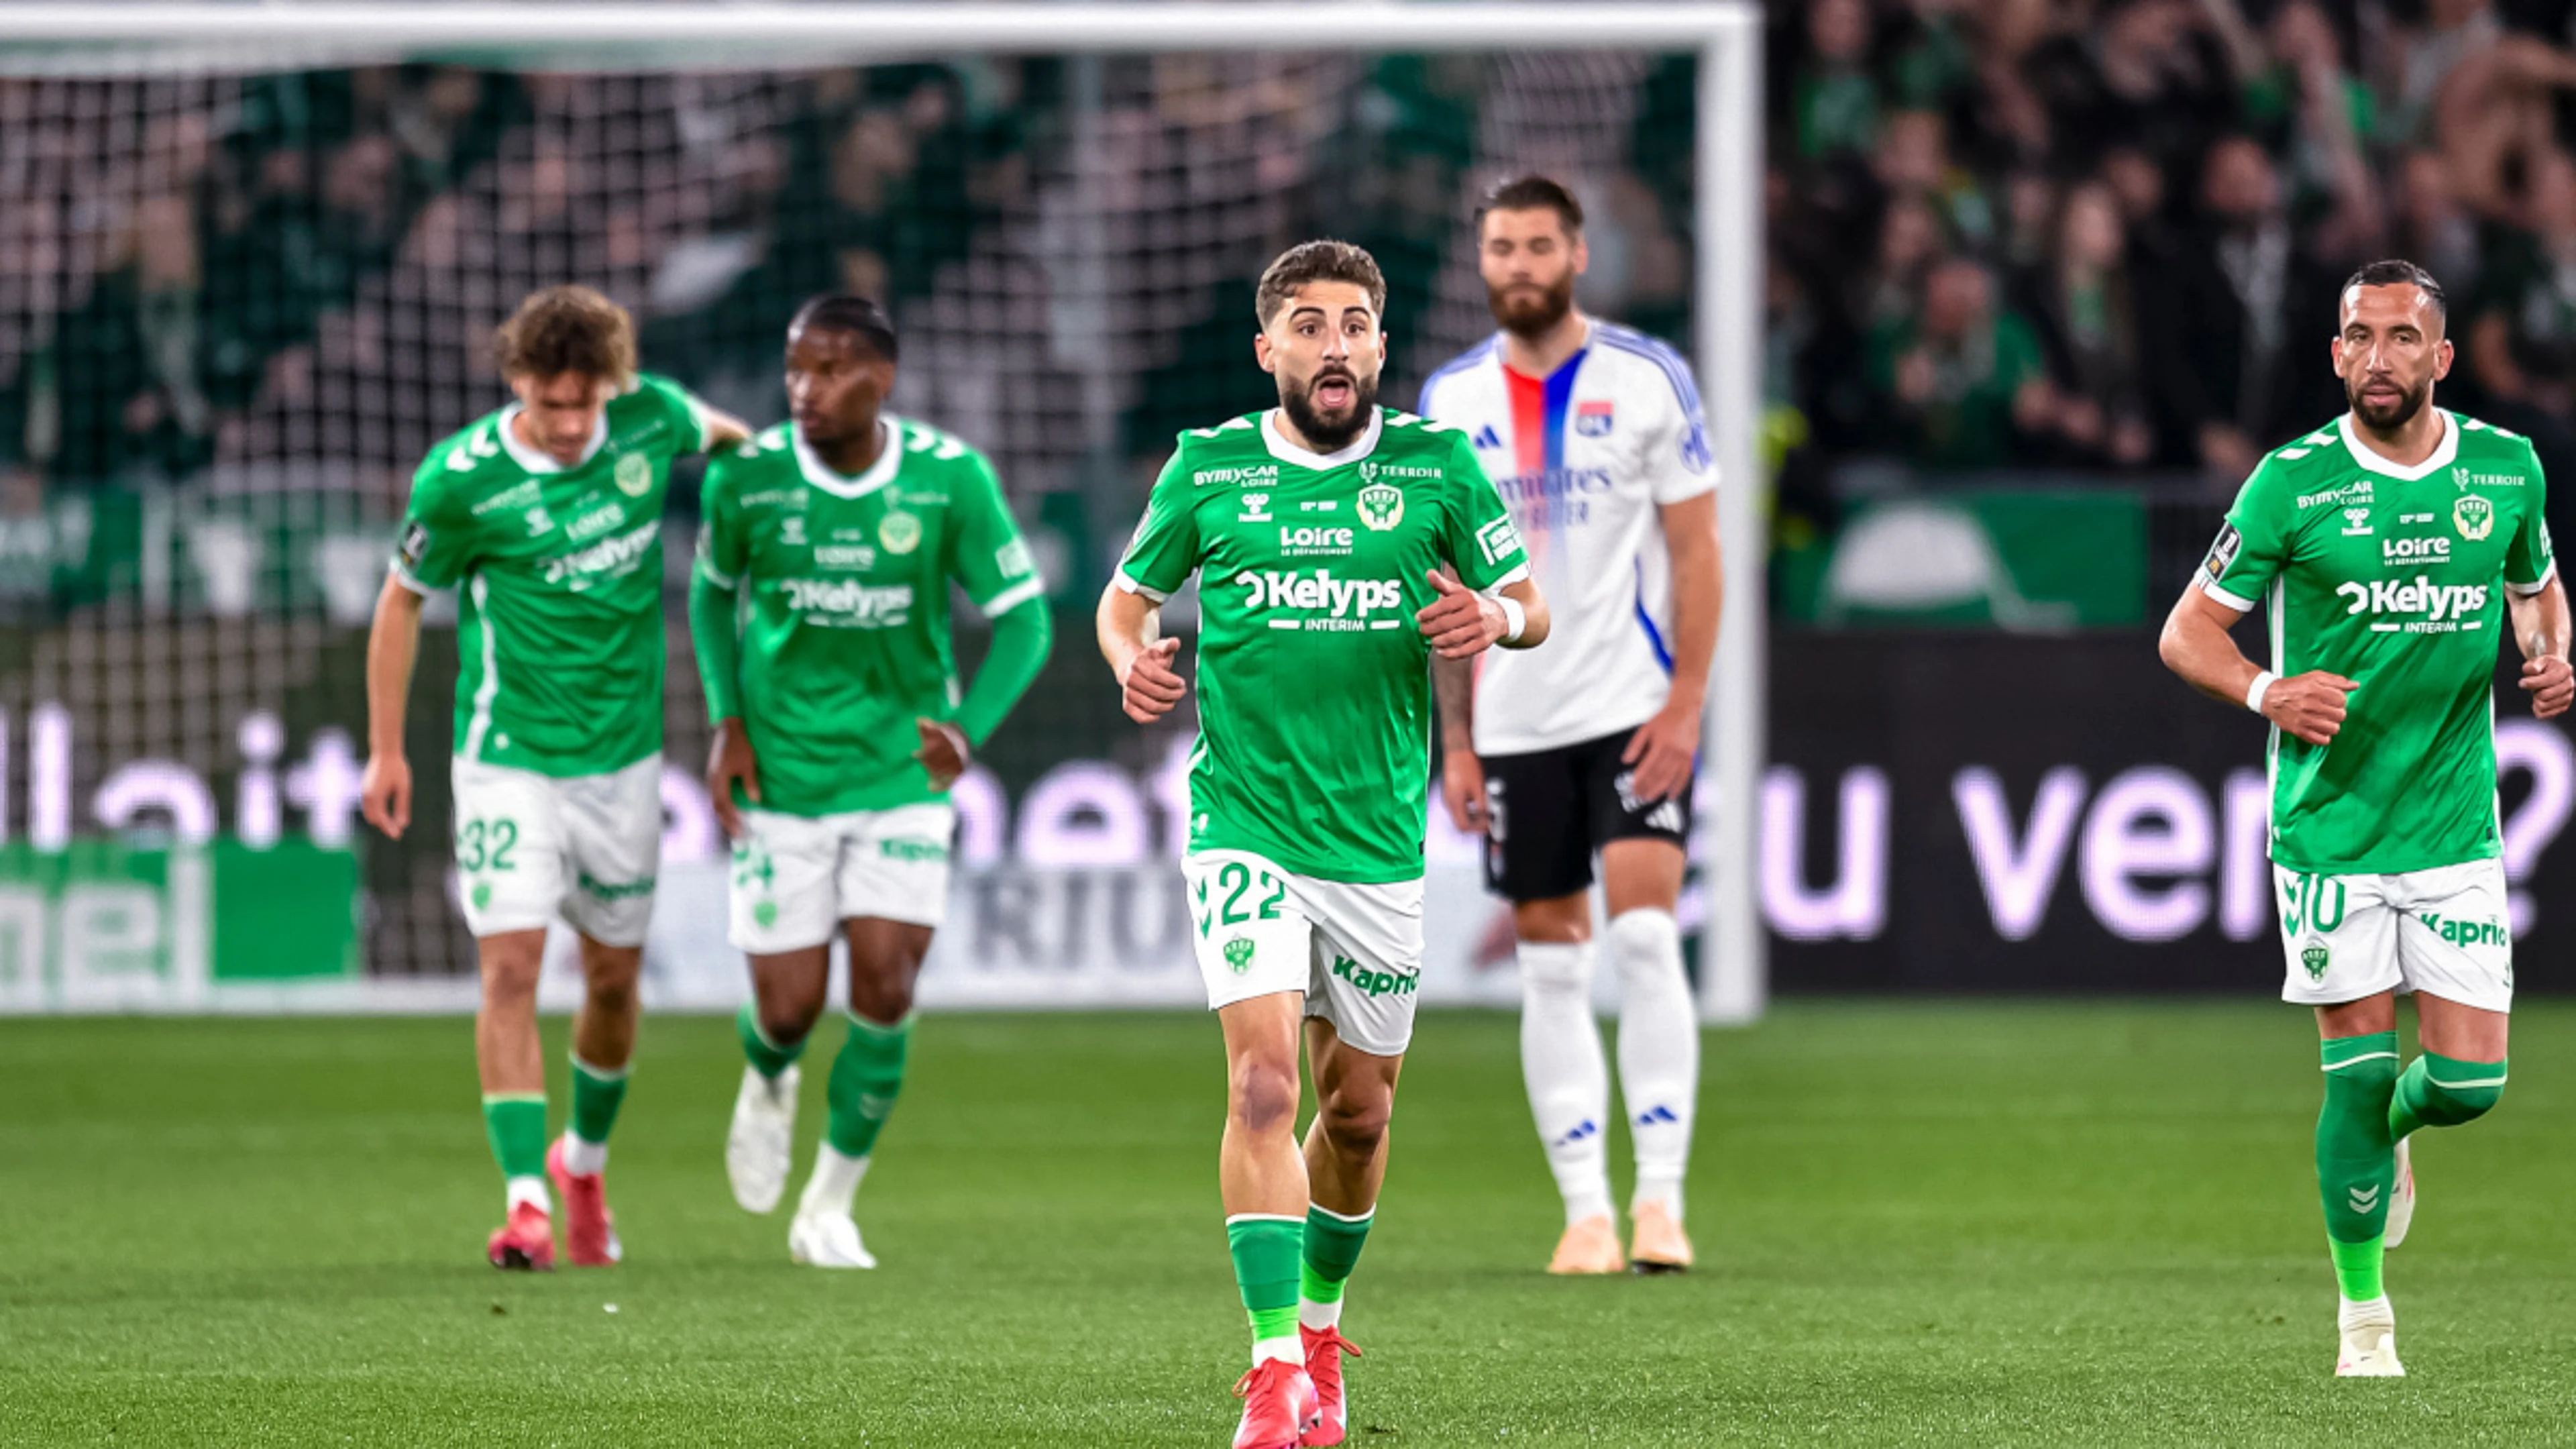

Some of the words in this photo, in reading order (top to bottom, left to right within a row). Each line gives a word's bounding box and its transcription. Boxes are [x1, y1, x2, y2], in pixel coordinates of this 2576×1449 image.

[1381, 465, 1442, 479] TERROIR
[2471, 474, 2526, 486] TERROIR
[1281, 526, 1353, 547] Loire
[2383, 537, 2451, 557] Loire
[1265, 569, 1402, 617] Kelyps
[2369, 575, 2487, 621] Kelyps
[466, 818, 517, 872] 32
[1219, 862, 1285, 926] 22
[2297, 873, 2345, 934] 10
